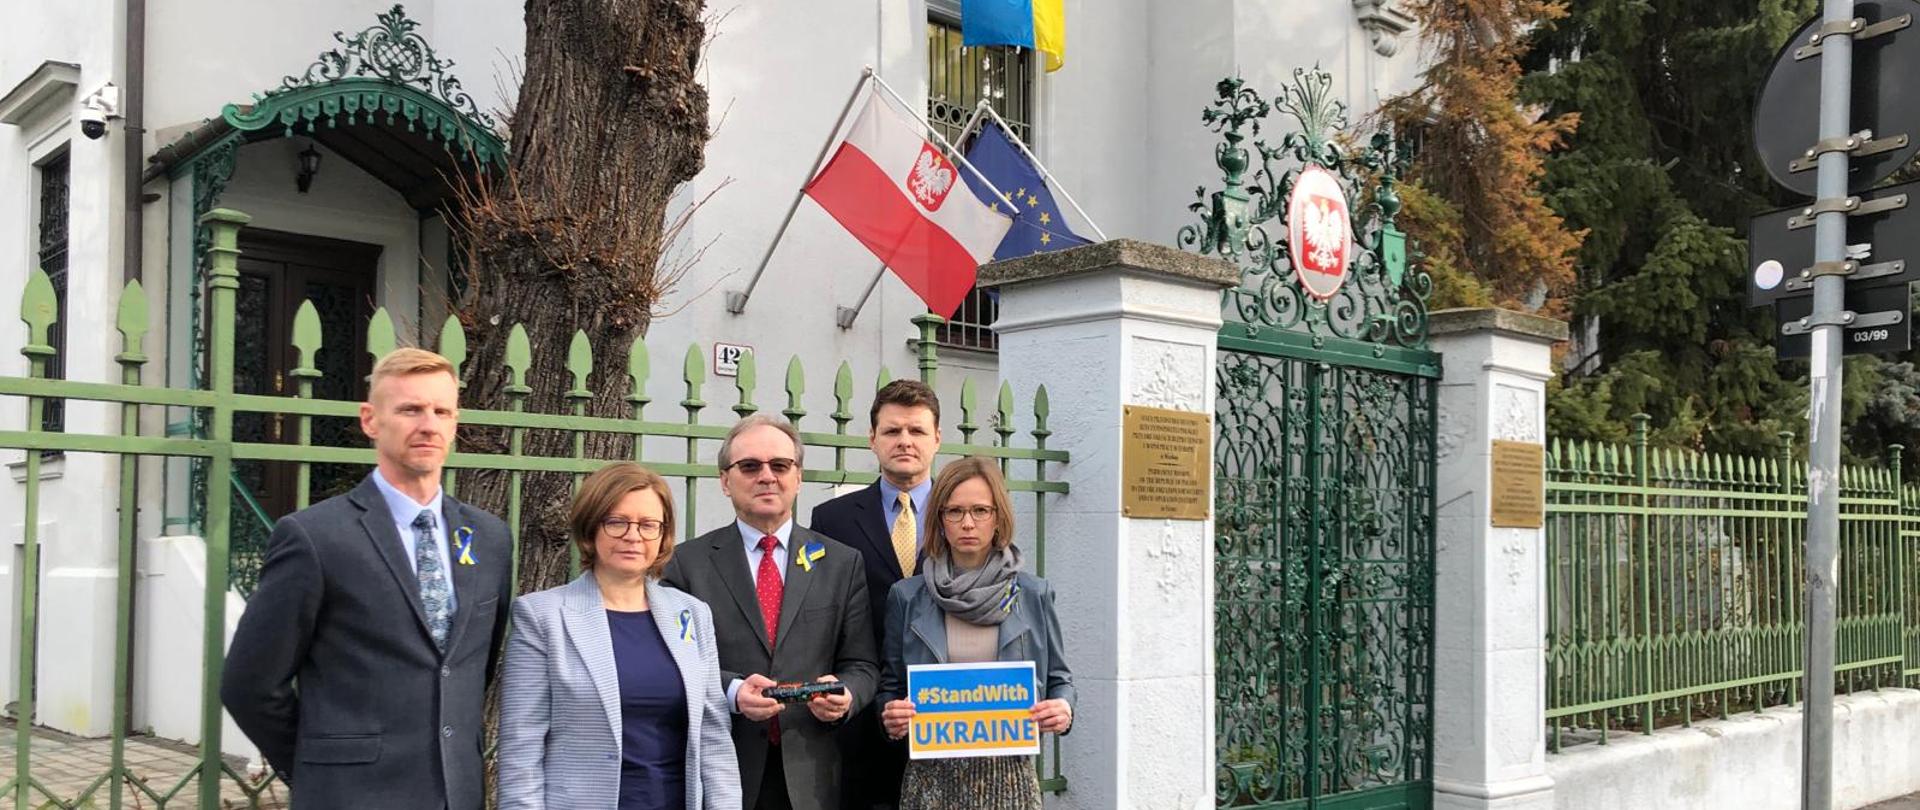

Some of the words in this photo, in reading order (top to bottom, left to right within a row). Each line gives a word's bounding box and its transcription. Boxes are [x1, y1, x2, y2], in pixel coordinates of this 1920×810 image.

[1854, 329, 1889, 343] 03/99
[917, 683, 1029, 705] #StandWith
[914, 717, 1036, 746] UKRAINE
